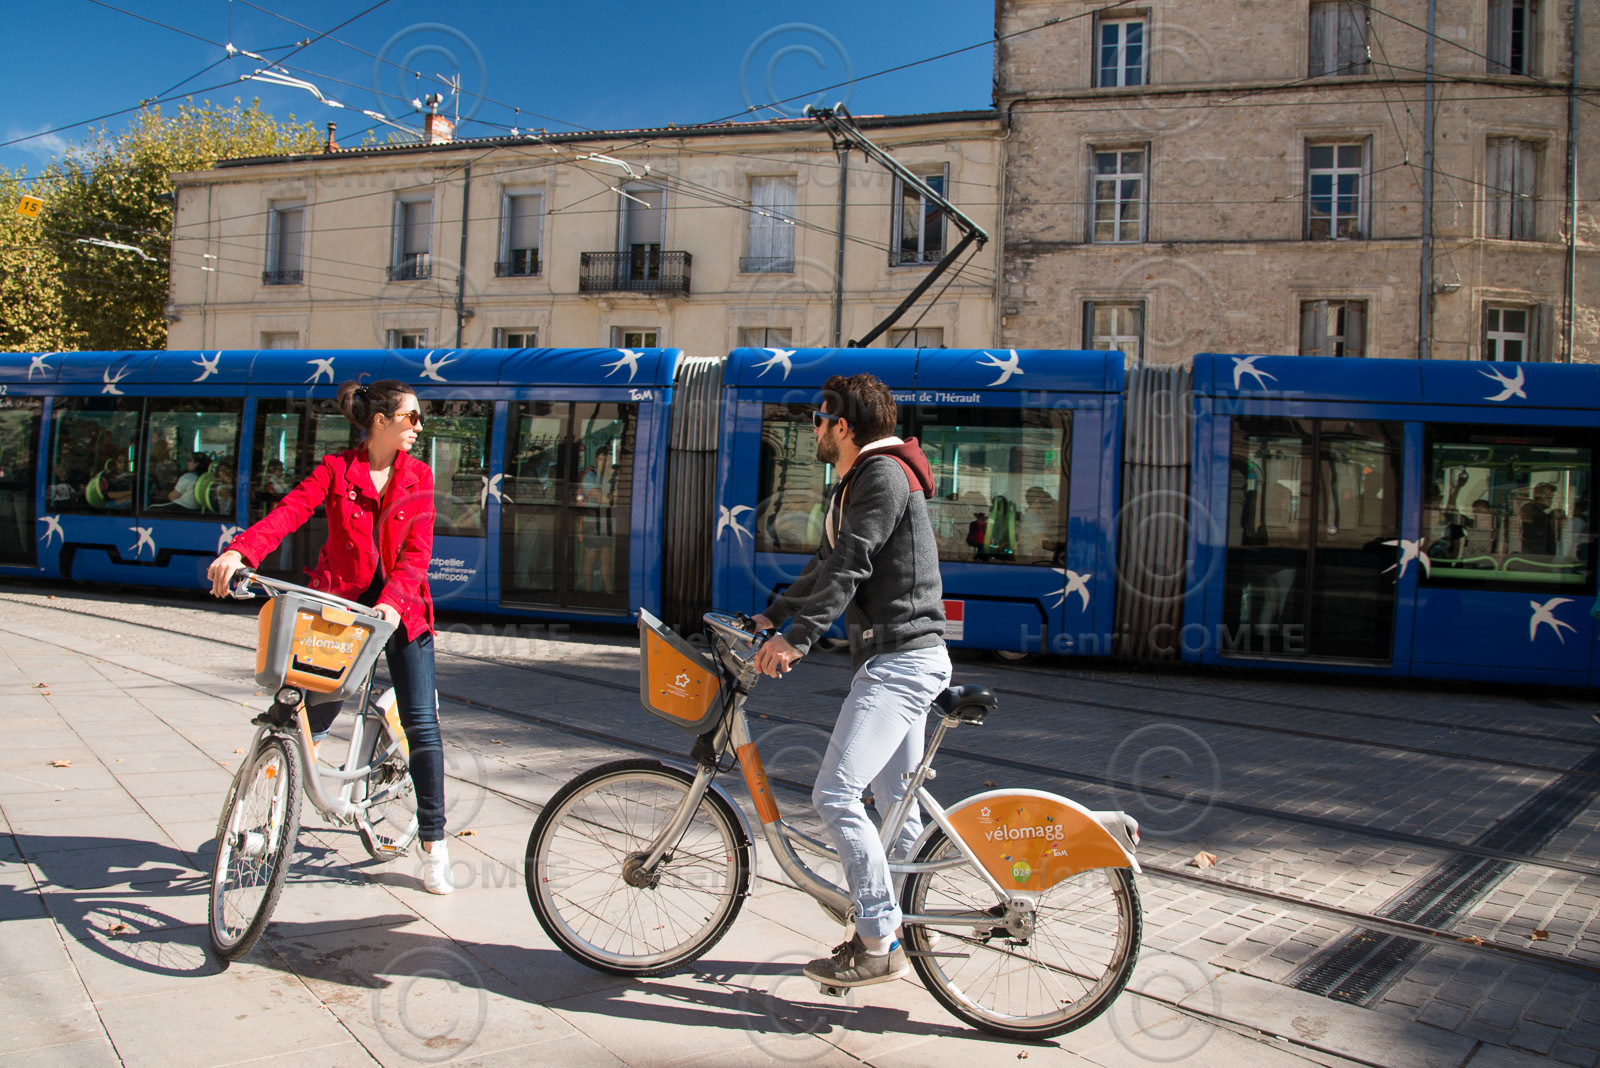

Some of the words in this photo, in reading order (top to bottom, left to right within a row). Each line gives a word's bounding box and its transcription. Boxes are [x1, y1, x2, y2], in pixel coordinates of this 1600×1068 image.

[24, 201, 38, 212] 15
[919, 392, 933, 402] de
[935, 392, 981, 403] l'Hérault
[299, 635, 354, 653] vélomagg
[985, 824, 1065, 842] vélomagg
[1013, 868, 1031, 877] 024
